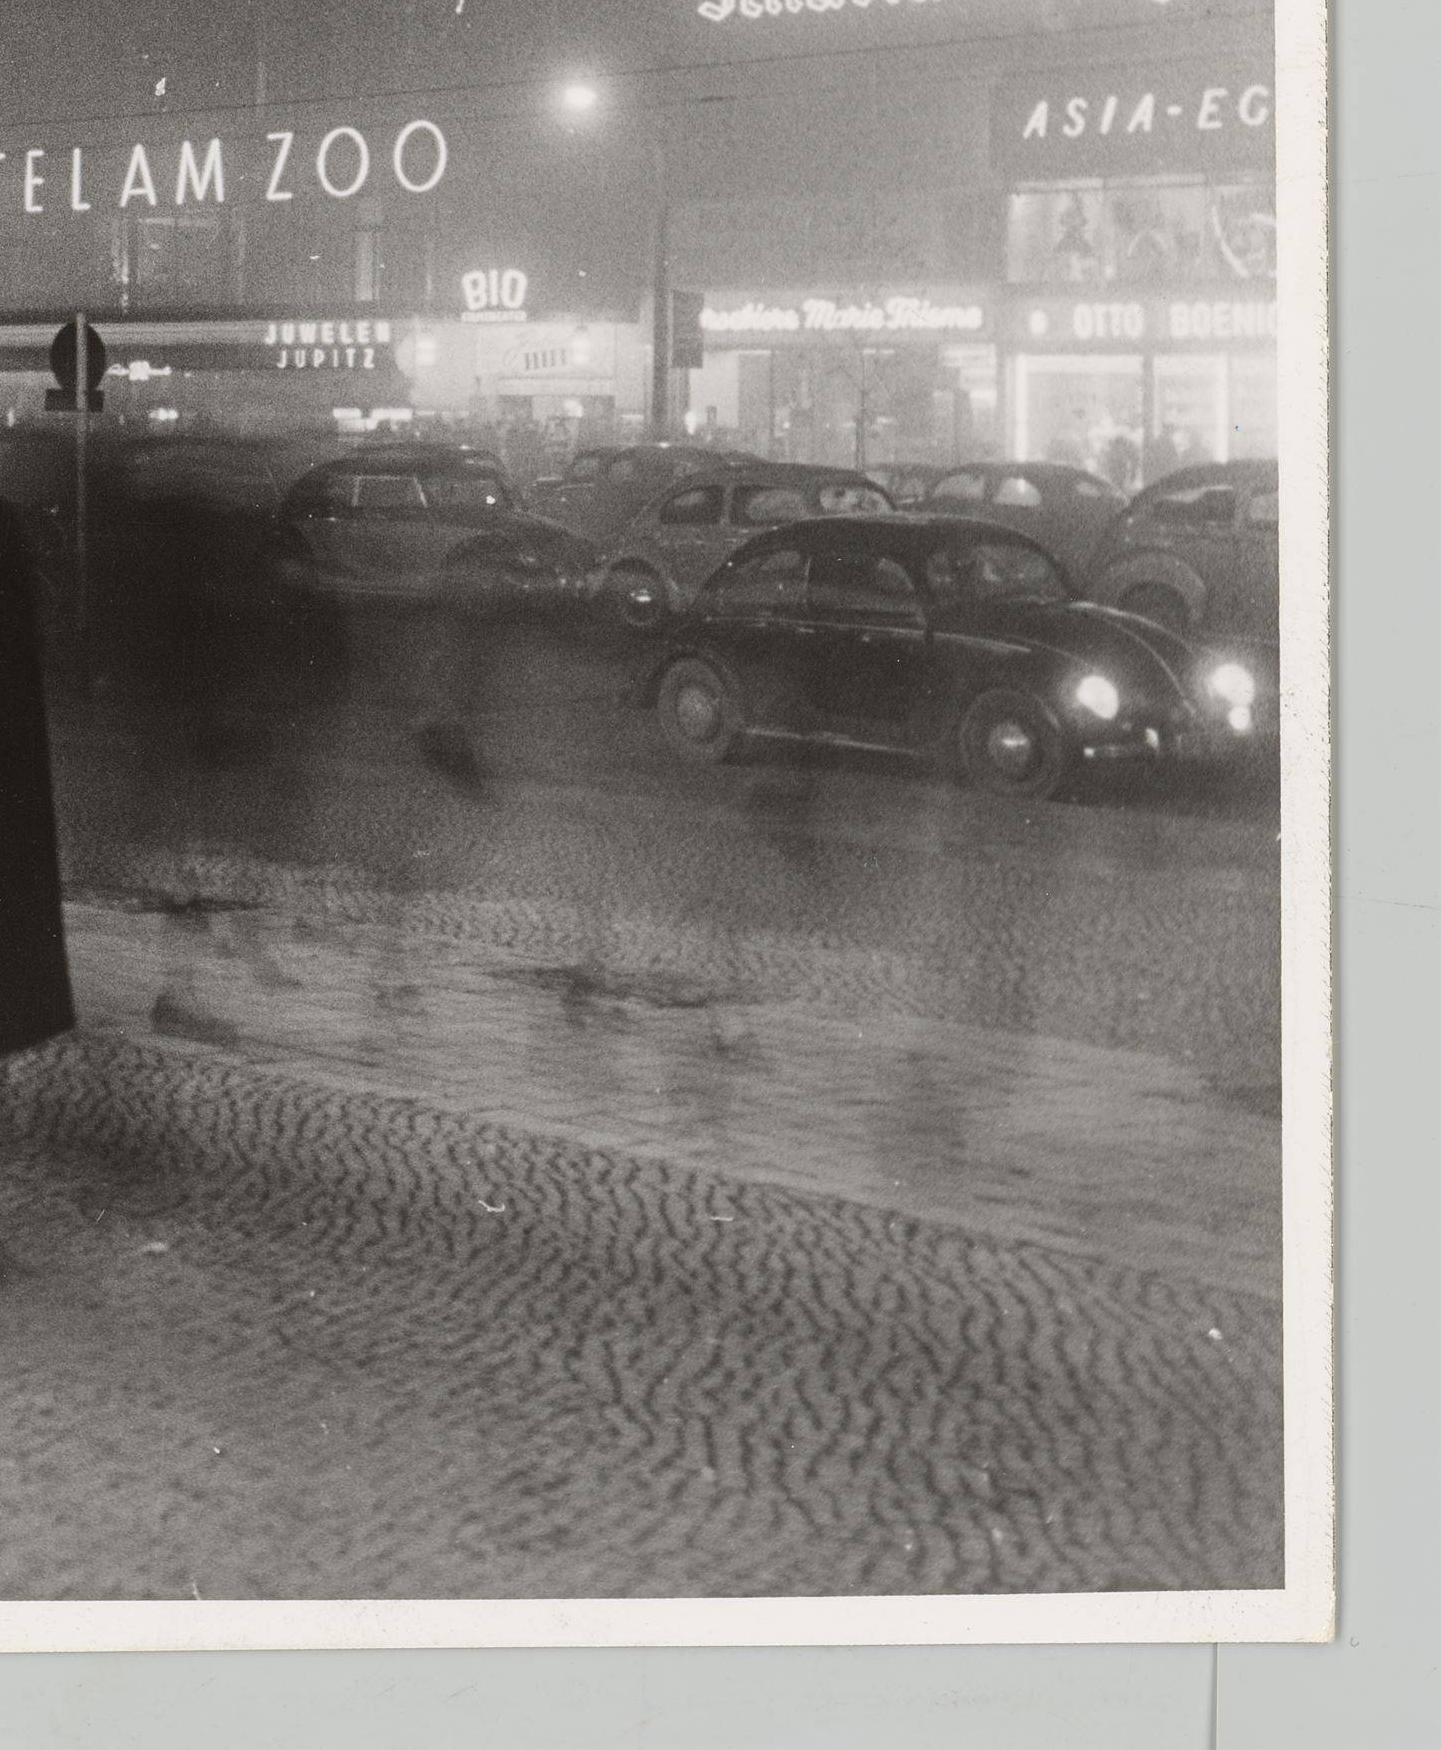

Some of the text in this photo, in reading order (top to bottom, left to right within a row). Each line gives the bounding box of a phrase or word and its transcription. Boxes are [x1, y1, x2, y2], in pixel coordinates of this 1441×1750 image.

[120, 138, 225, 208] AM
[266, 120, 447, 201] ZOO
[461, 268, 528, 311] BIO
[1072, 303, 1144, 339] OTTO
